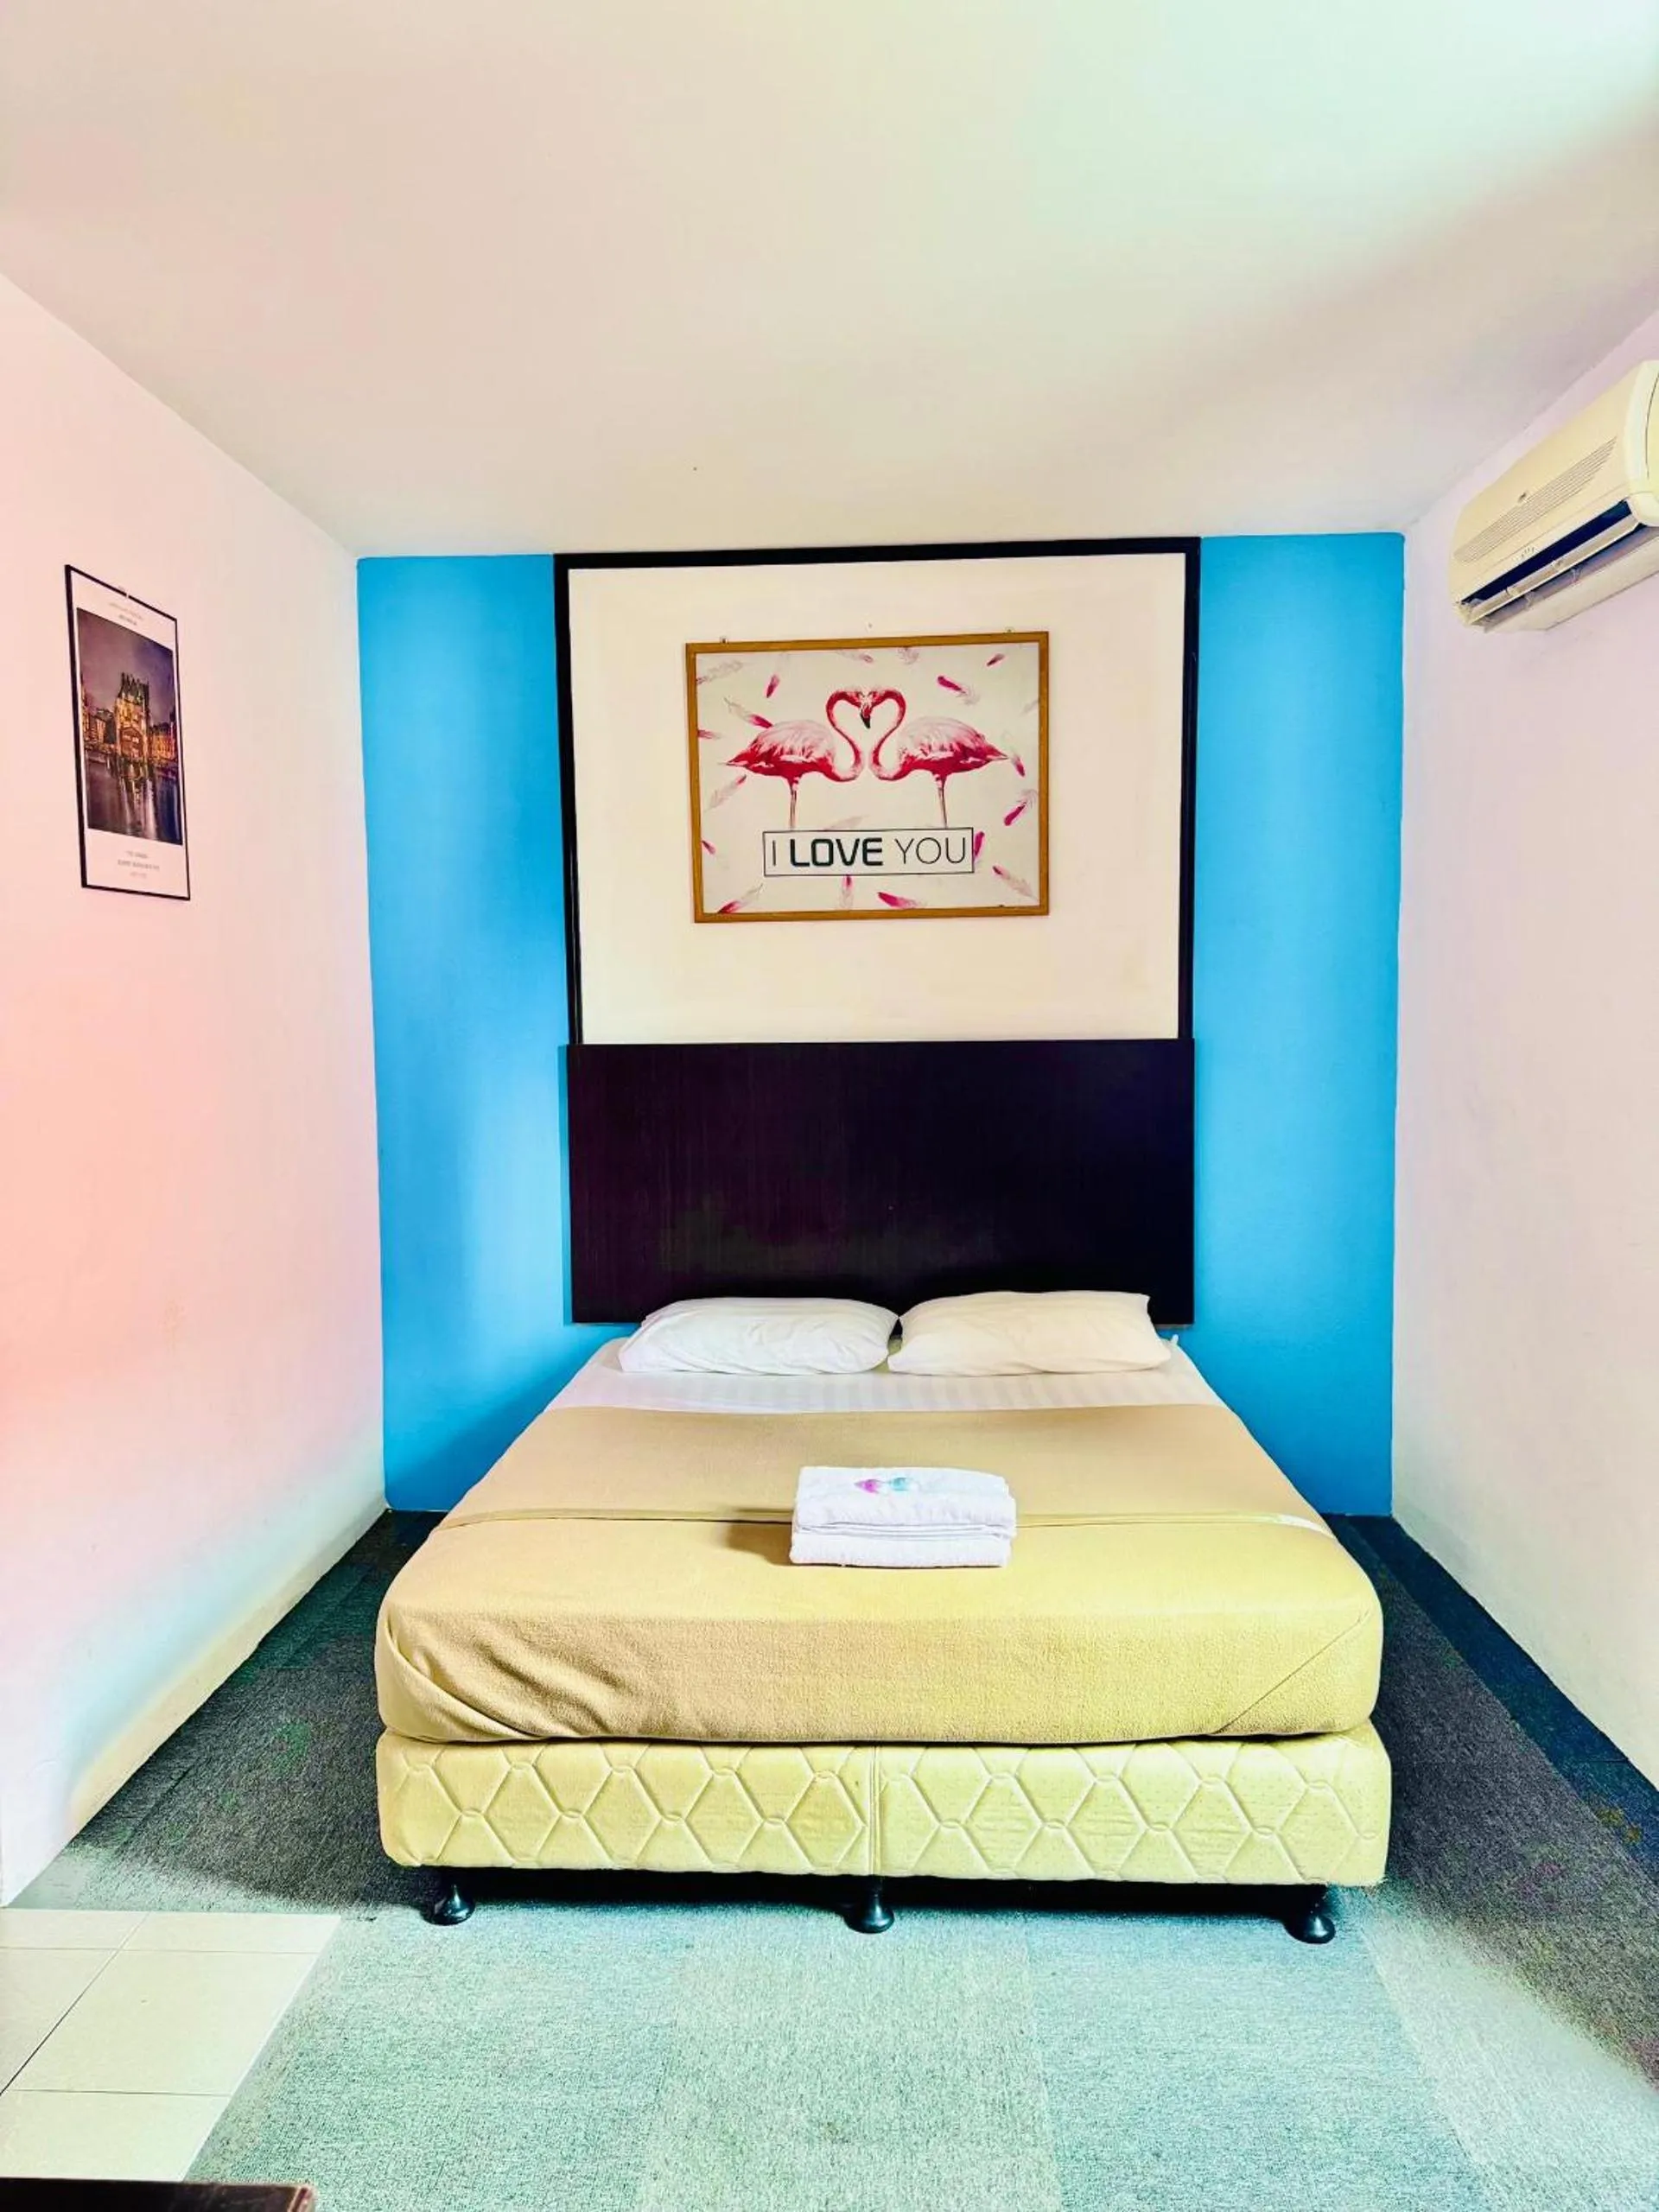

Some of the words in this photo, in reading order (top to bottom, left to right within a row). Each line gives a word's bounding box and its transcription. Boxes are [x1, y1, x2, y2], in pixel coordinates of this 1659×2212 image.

[772, 840, 777, 866] I
[790, 838, 883, 867] LOVE
[895, 837, 965, 864] YOU
